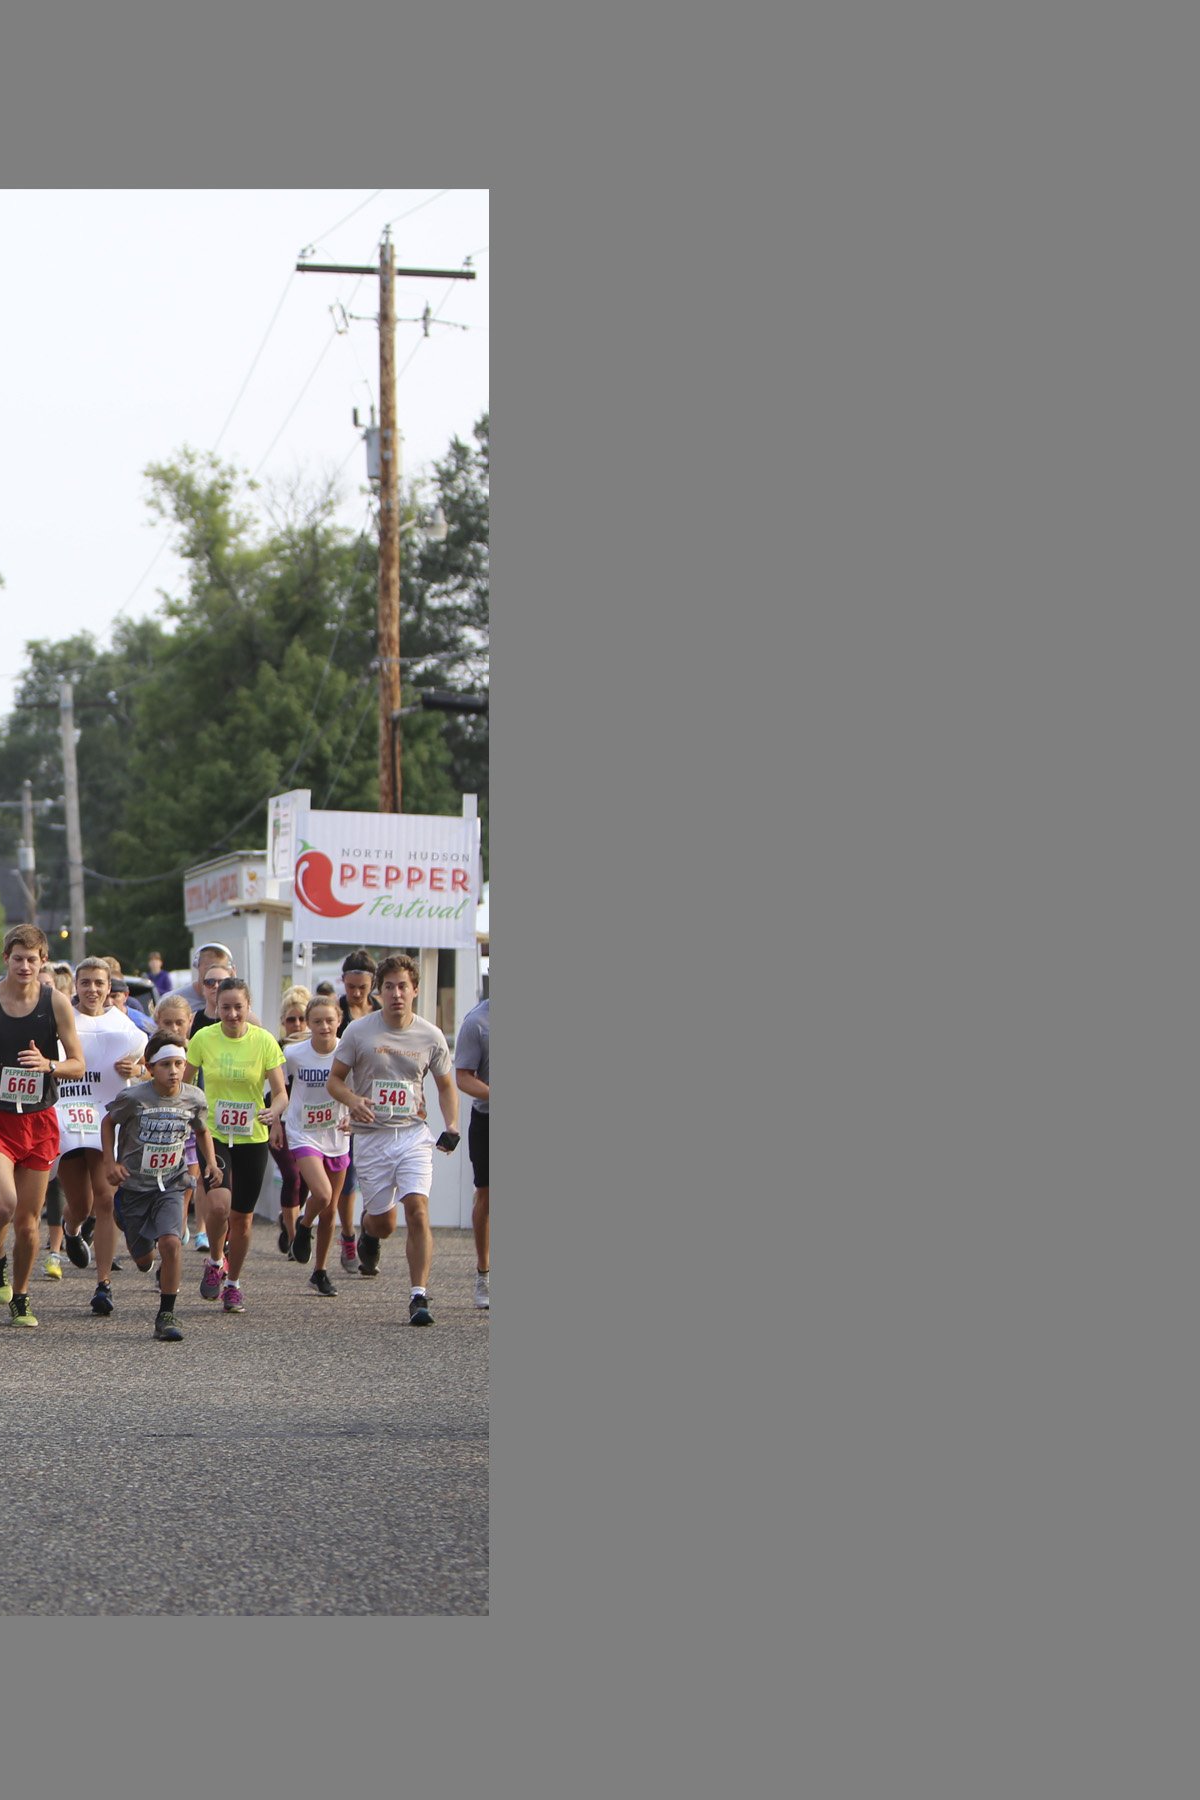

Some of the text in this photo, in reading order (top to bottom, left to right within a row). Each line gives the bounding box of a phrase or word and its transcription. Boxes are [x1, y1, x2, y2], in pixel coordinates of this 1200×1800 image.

[341, 848, 470, 862] NORTH HUDSON
[340, 863, 471, 893] PEPPER
[368, 895, 470, 919] Festival
[5, 1069, 41, 1077] PEPPERFEST
[298, 1069, 330, 1081] WOODB
[8, 1077, 36, 1095] 666
[60, 1085, 92, 1098] DENTAL
[218, 1101, 253, 1109] PEPPERFEST
[379, 1089, 406, 1106] 548
[68, 1109, 94, 1124] 566
[221, 1109, 248, 1126] 636
[307, 1109, 332, 1124] 598
[146, 1145, 182, 1153] PEPPERFEST
[150, 1152, 176, 1169] 634
